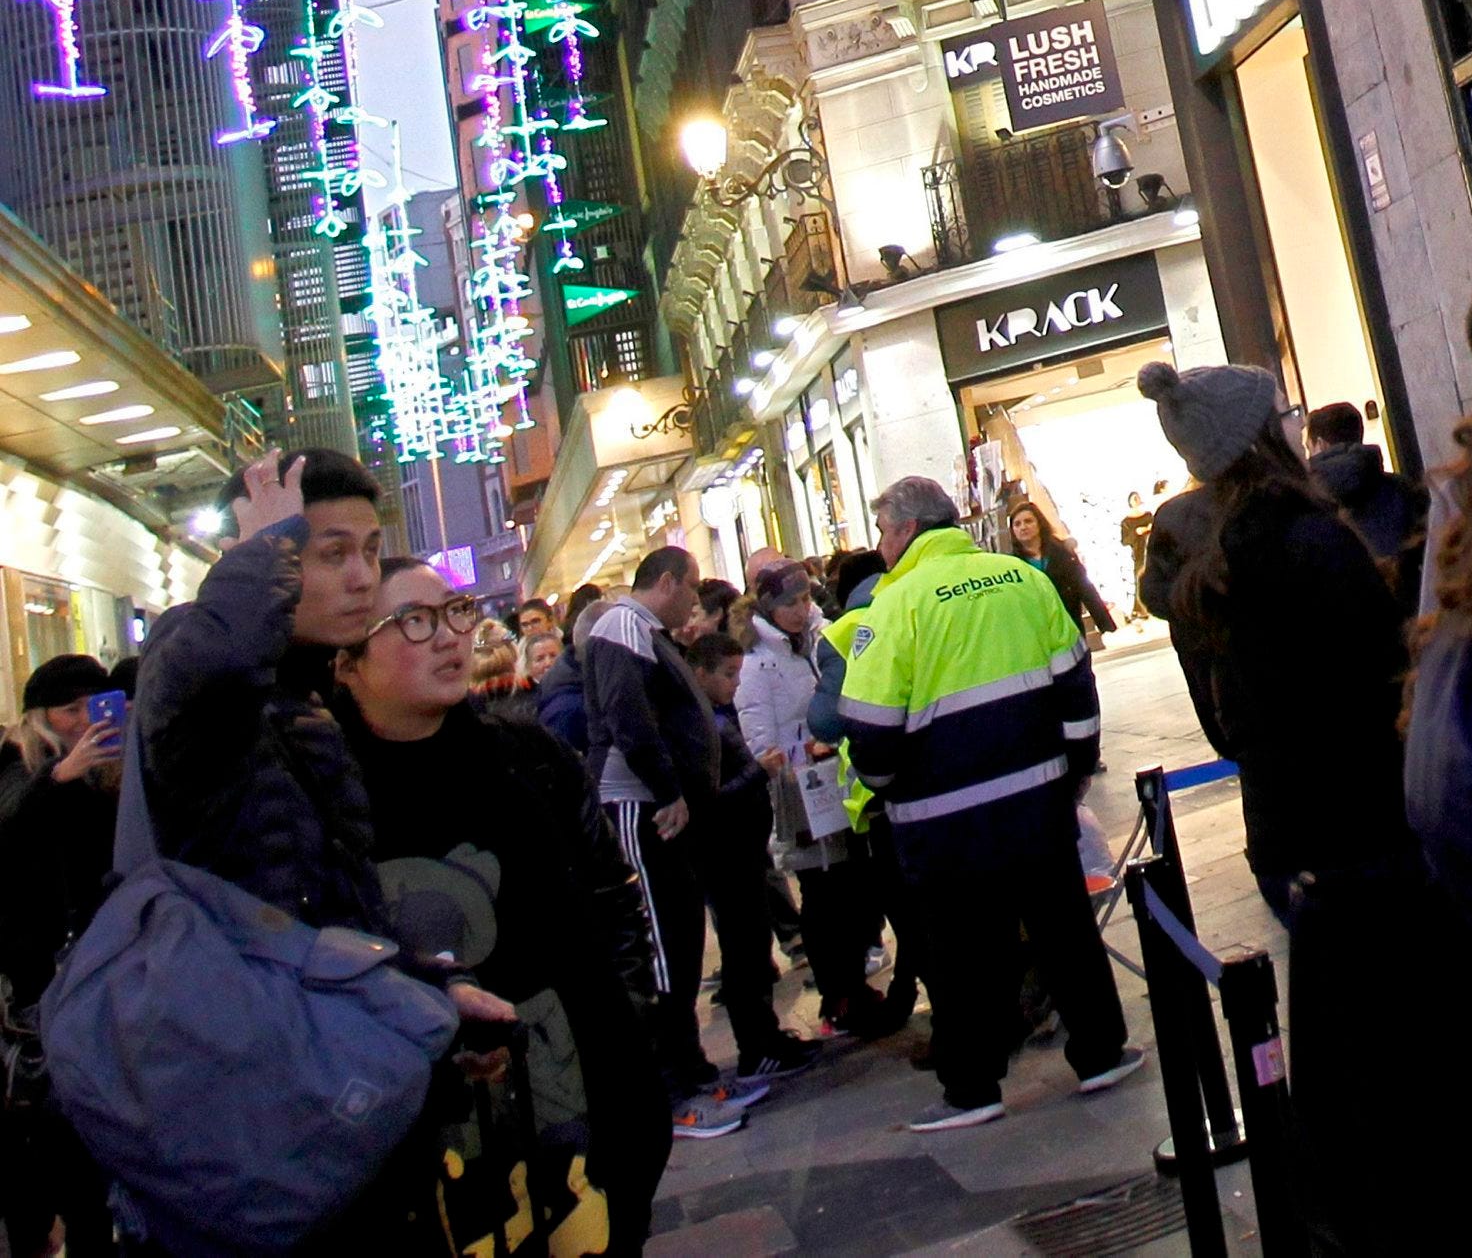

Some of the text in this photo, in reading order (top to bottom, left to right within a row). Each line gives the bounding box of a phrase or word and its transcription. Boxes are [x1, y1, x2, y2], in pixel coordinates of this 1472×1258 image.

[1008, 19, 1096, 61] LUSH
[1013, 44, 1100, 83] FRESH
[1018, 66, 1103, 97] HANDMADE
[1021, 80, 1106, 111] COSMETICS
[976, 283, 1126, 353] KRACK
